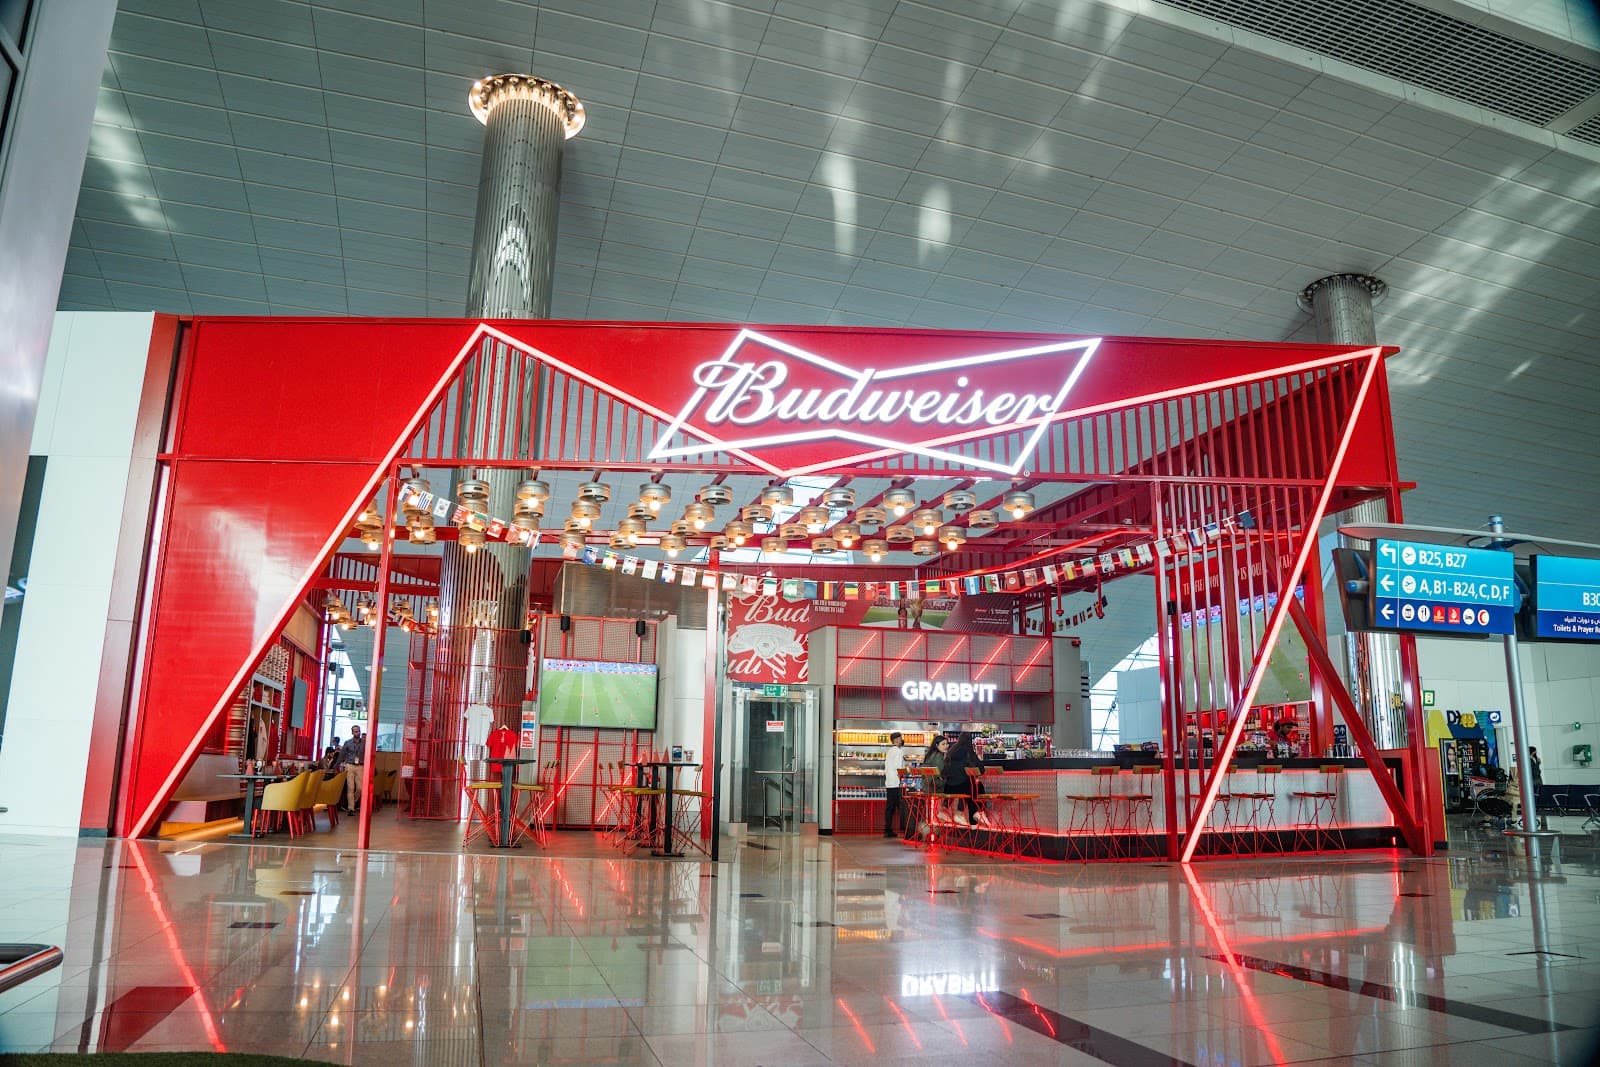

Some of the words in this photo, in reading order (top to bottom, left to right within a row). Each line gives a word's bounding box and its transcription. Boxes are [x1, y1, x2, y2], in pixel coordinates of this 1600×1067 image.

[693, 361, 1056, 425] Budweiser
[1553, 624, 1571, 632] Toilets
[1578, 626, 1594, 634] Prayer
[902, 680, 997, 702] GRABB'IT
